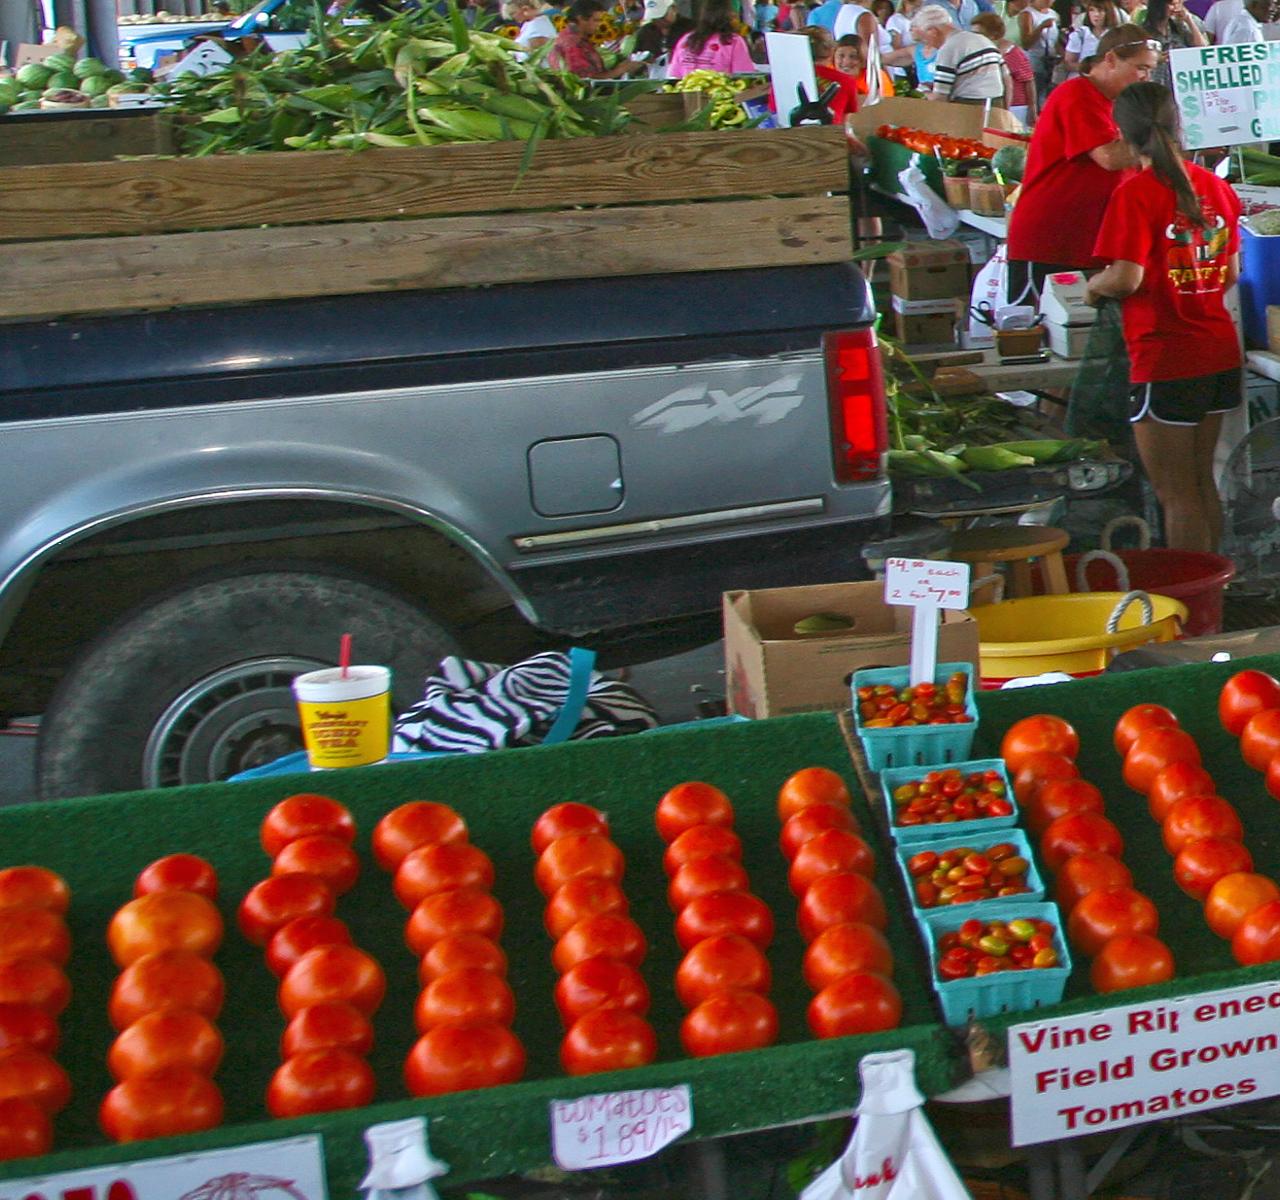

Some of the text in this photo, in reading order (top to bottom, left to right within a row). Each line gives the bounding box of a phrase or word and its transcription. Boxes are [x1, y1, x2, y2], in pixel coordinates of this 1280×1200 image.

[1175, 64, 1263, 93] SHELLED
[1018, 1022, 1113, 1054] Vine
[1035, 1032, 1279, 1094] Field Grown
[1057, 1077, 1257, 1131] Tomatoes
